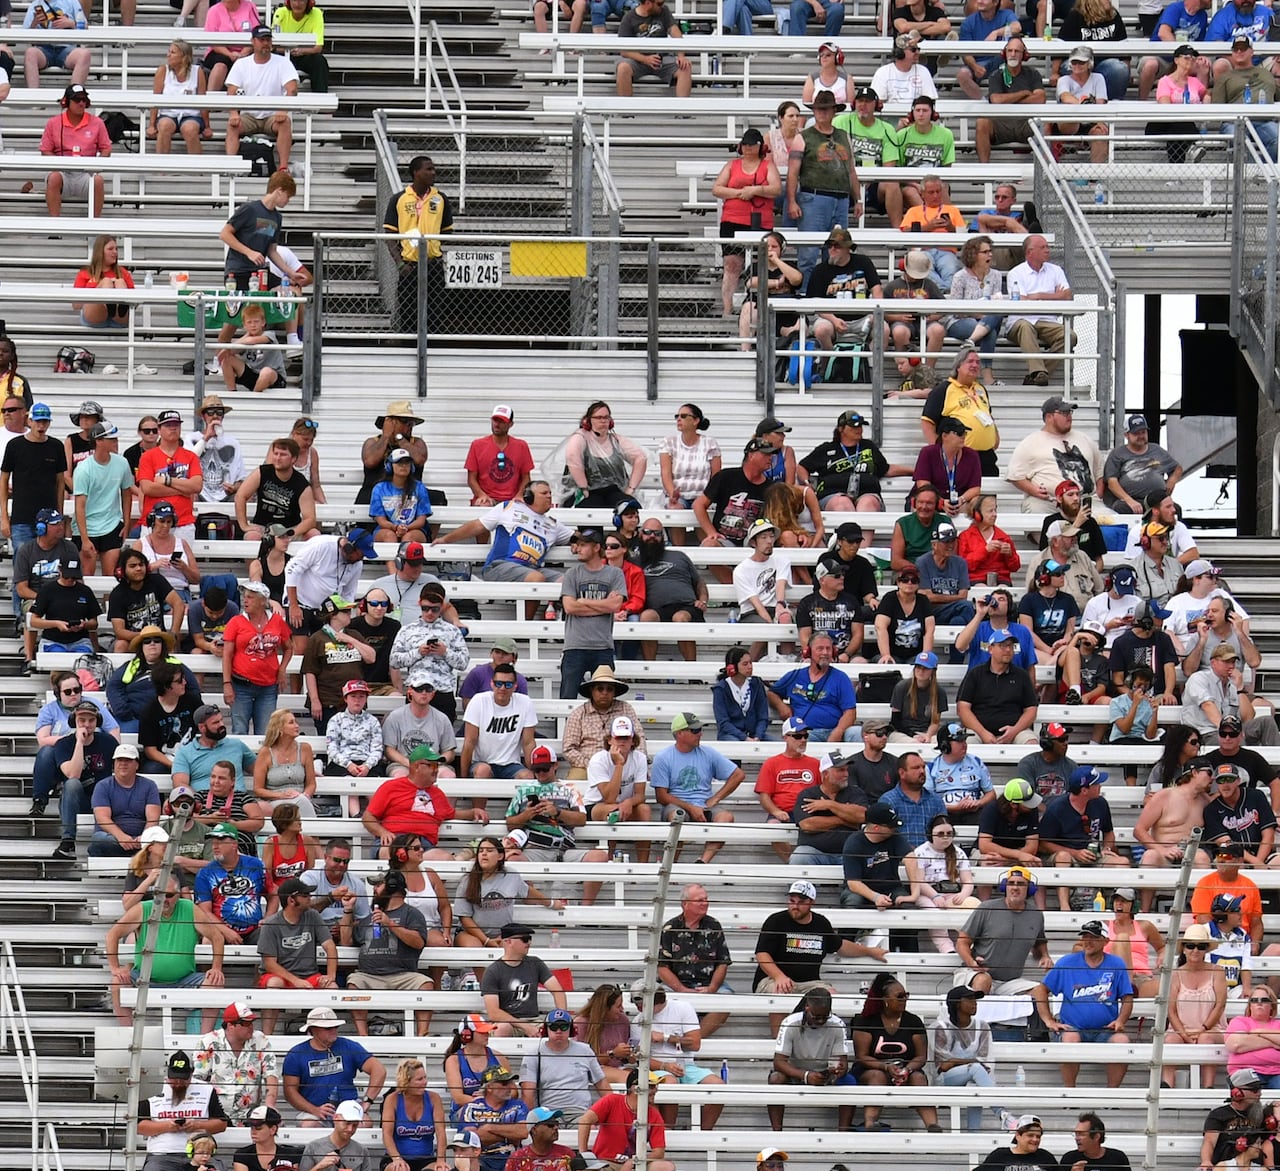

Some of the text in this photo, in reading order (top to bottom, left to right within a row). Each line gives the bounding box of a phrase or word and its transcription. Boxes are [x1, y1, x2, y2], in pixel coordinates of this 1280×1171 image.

[1231, 22, 1263, 36] LARSON
[905, 146, 943, 158] BUSCH
[453, 252, 493, 262] SECTIONS
[1041, 609, 1065, 627] 19
[486, 714, 520, 734] NIKE
[1101, 971, 1113, 985] 5
[1072, 982, 1112, 998] LARSON
[157, 1110, 203, 1119] DISCOUNT
